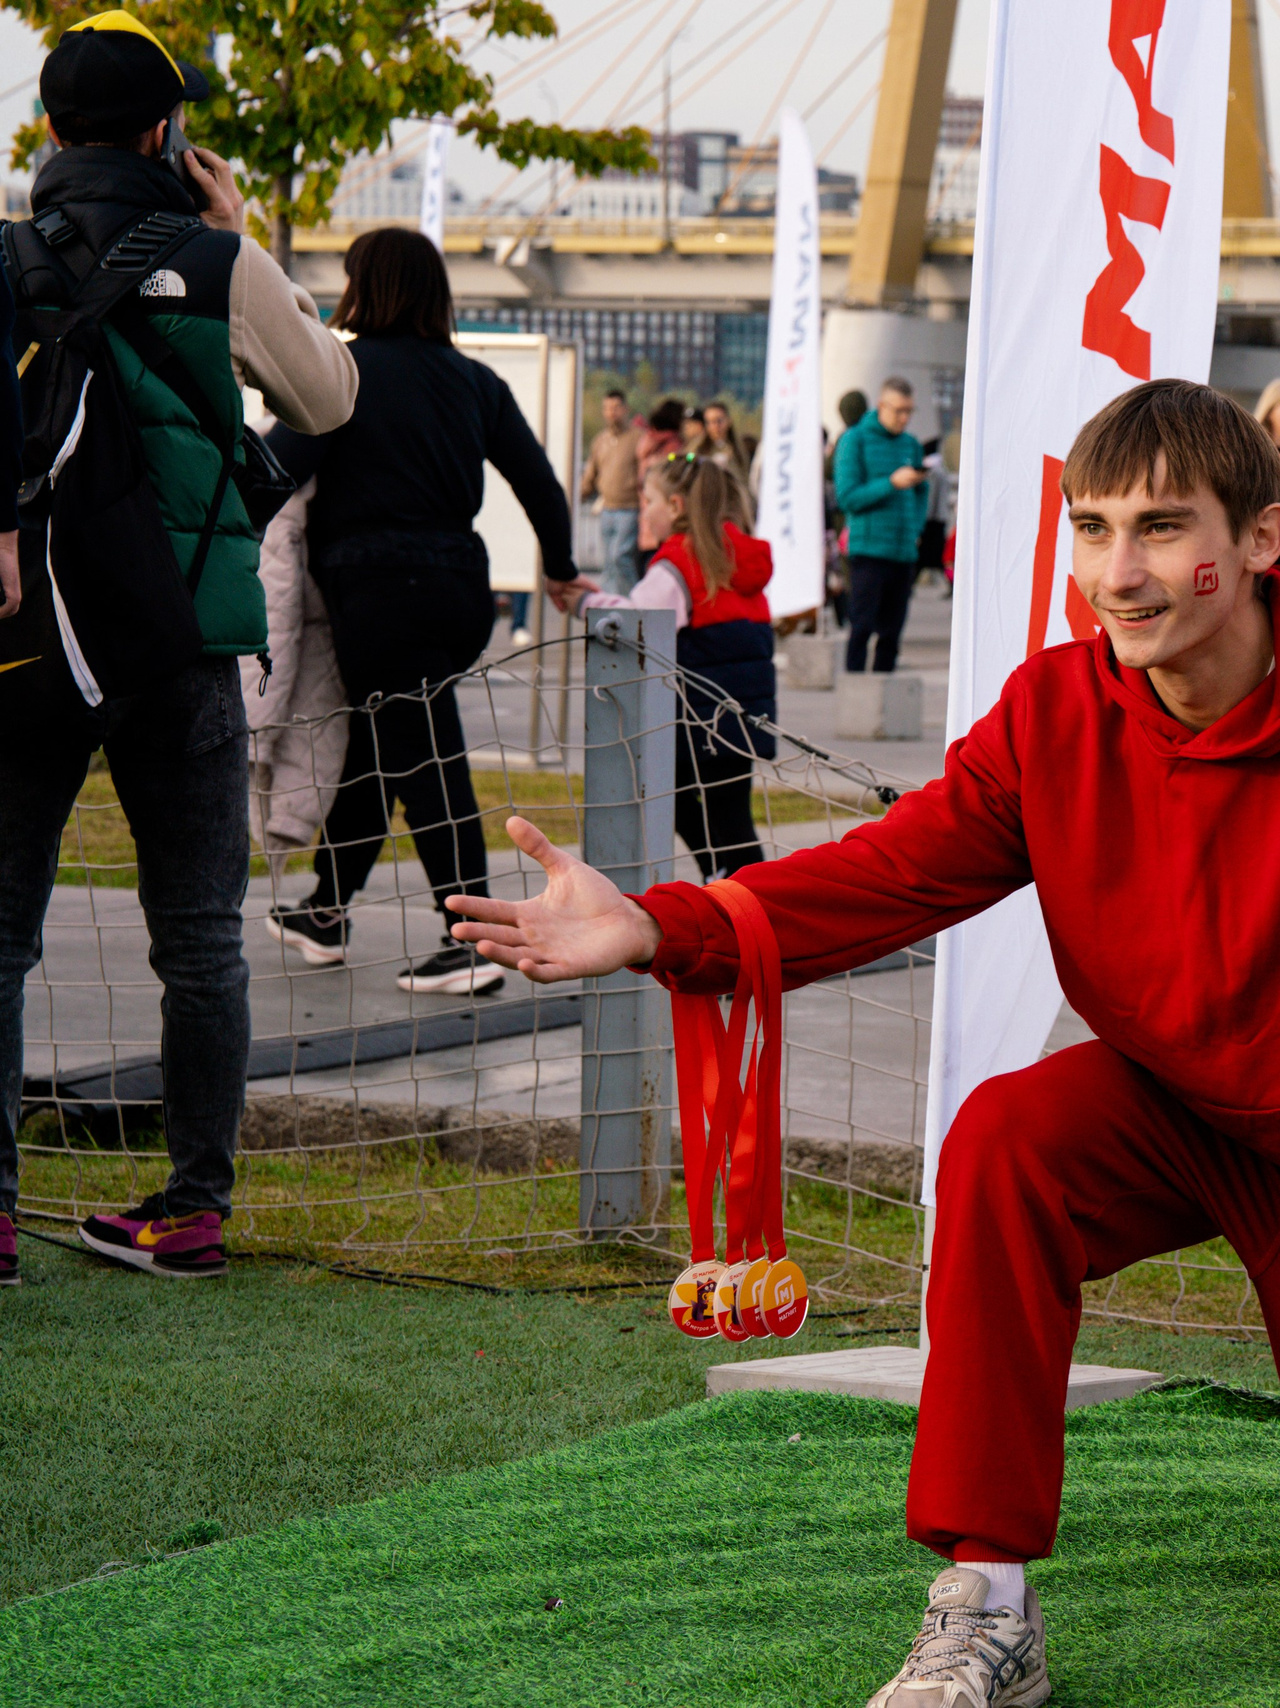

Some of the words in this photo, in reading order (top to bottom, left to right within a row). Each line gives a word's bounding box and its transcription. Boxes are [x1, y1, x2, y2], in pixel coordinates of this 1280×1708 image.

[140, 287, 166, 297] FACE
[698, 1269, 718, 1277] МАГНИТ
[778, 1307, 797, 1322] МАГНИТ
